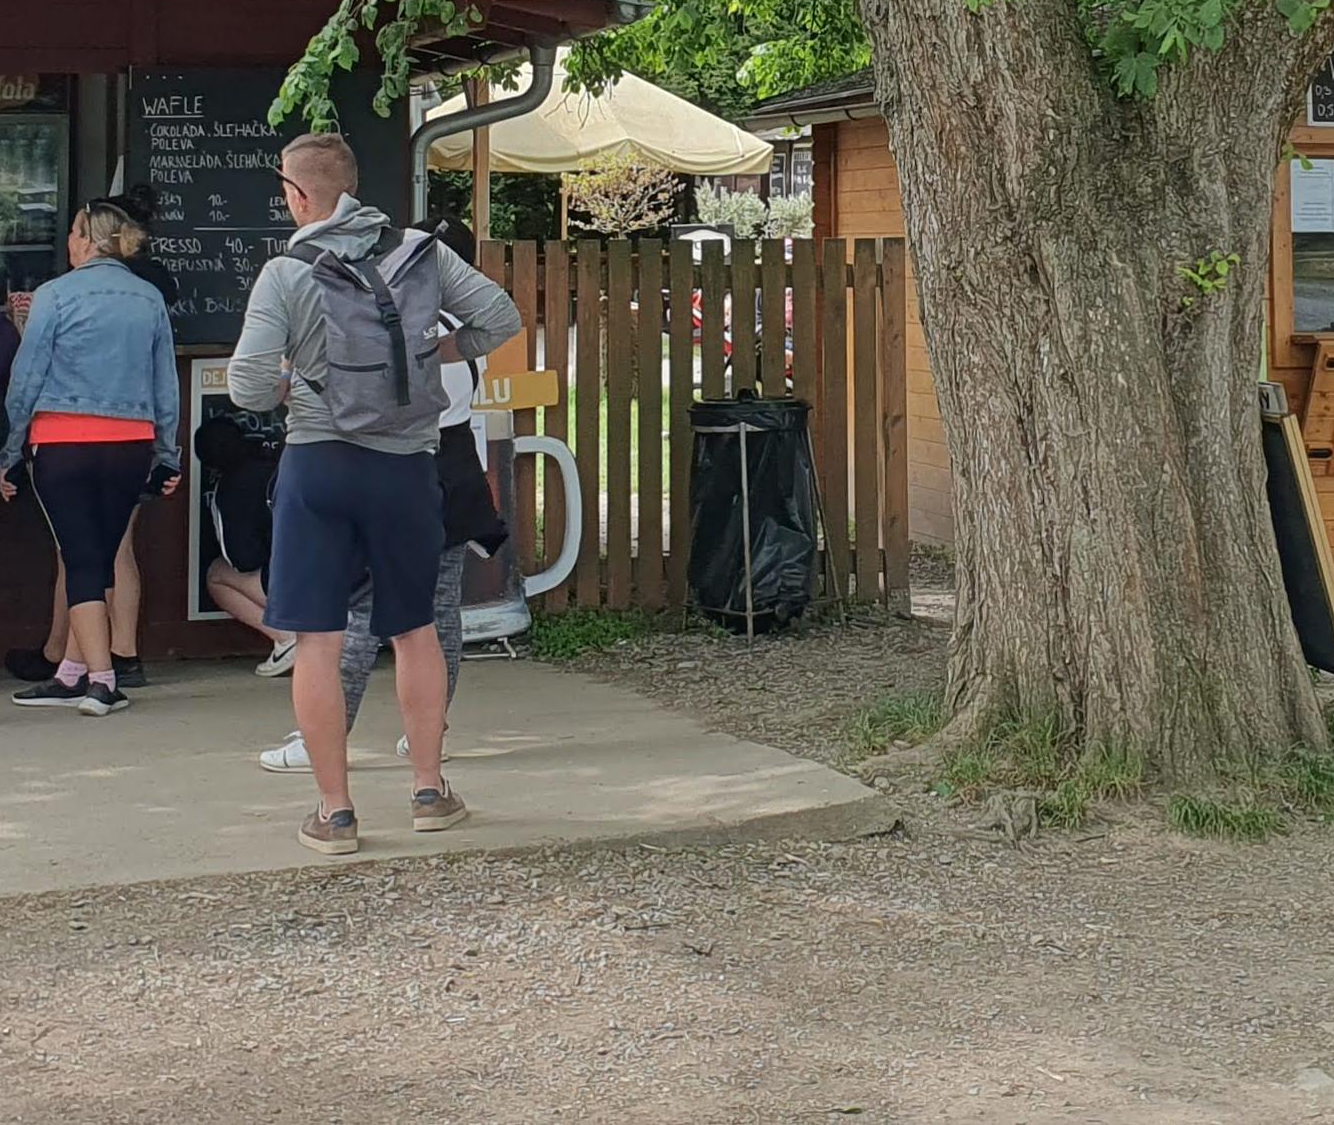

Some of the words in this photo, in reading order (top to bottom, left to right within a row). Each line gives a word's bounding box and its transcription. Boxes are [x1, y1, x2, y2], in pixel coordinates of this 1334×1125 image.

[142, 96, 204, 115] WAFLE
[151, 137, 195, 151] POLEVA
[150, 169, 194, 184] POLEVA
[202, 370, 227, 385] DEJ
